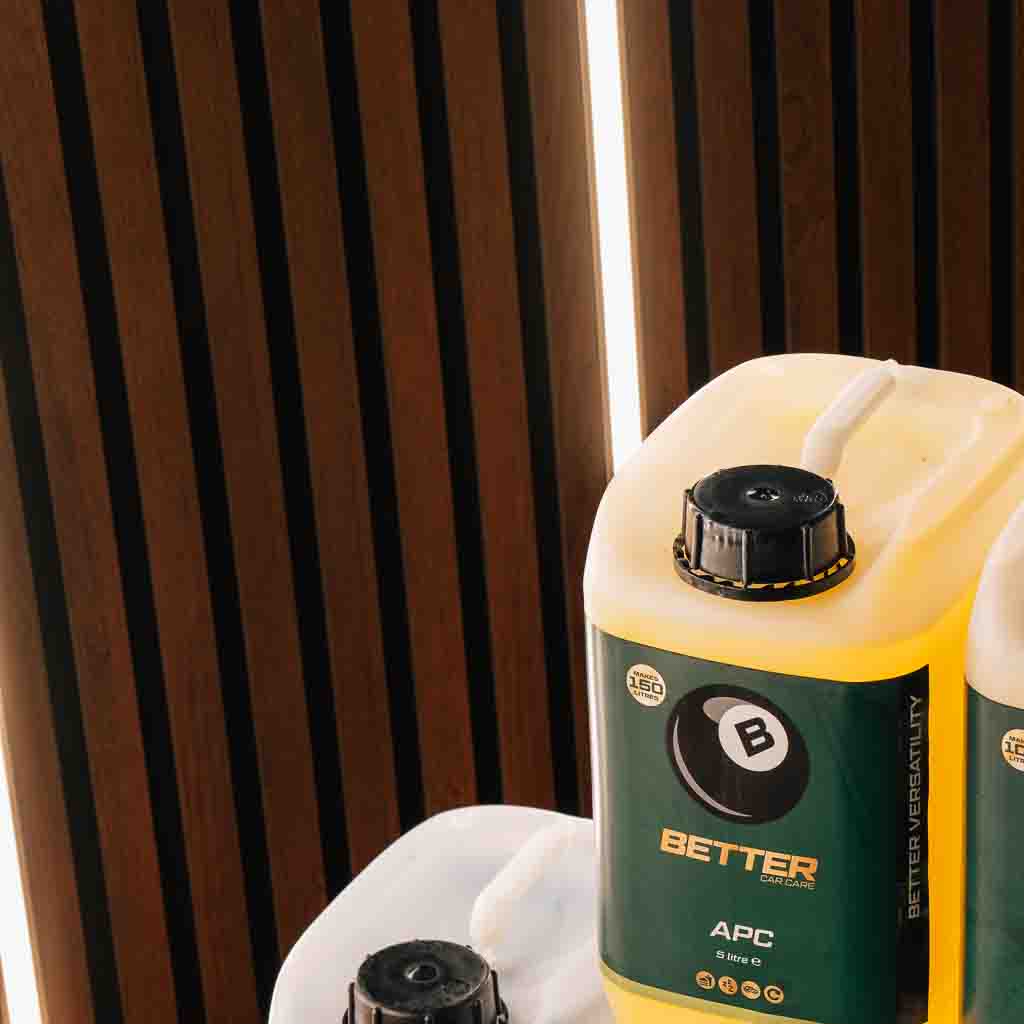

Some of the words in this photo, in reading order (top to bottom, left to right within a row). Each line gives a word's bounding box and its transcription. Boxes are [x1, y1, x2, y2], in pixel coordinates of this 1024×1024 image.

[629, 676, 664, 695] 150
[734, 716, 775, 757] B
[909, 695, 922, 831] VERSATILITY
[660, 828, 818, 881] BETTER
[760, 874, 784, 885] CAR
[784, 878, 816, 890] CARE
[908, 836, 921, 919] BETTER
[710, 921, 775, 948] APC
[716, 950, 726, 959] 5
[727, 952, 748, 965] litre
